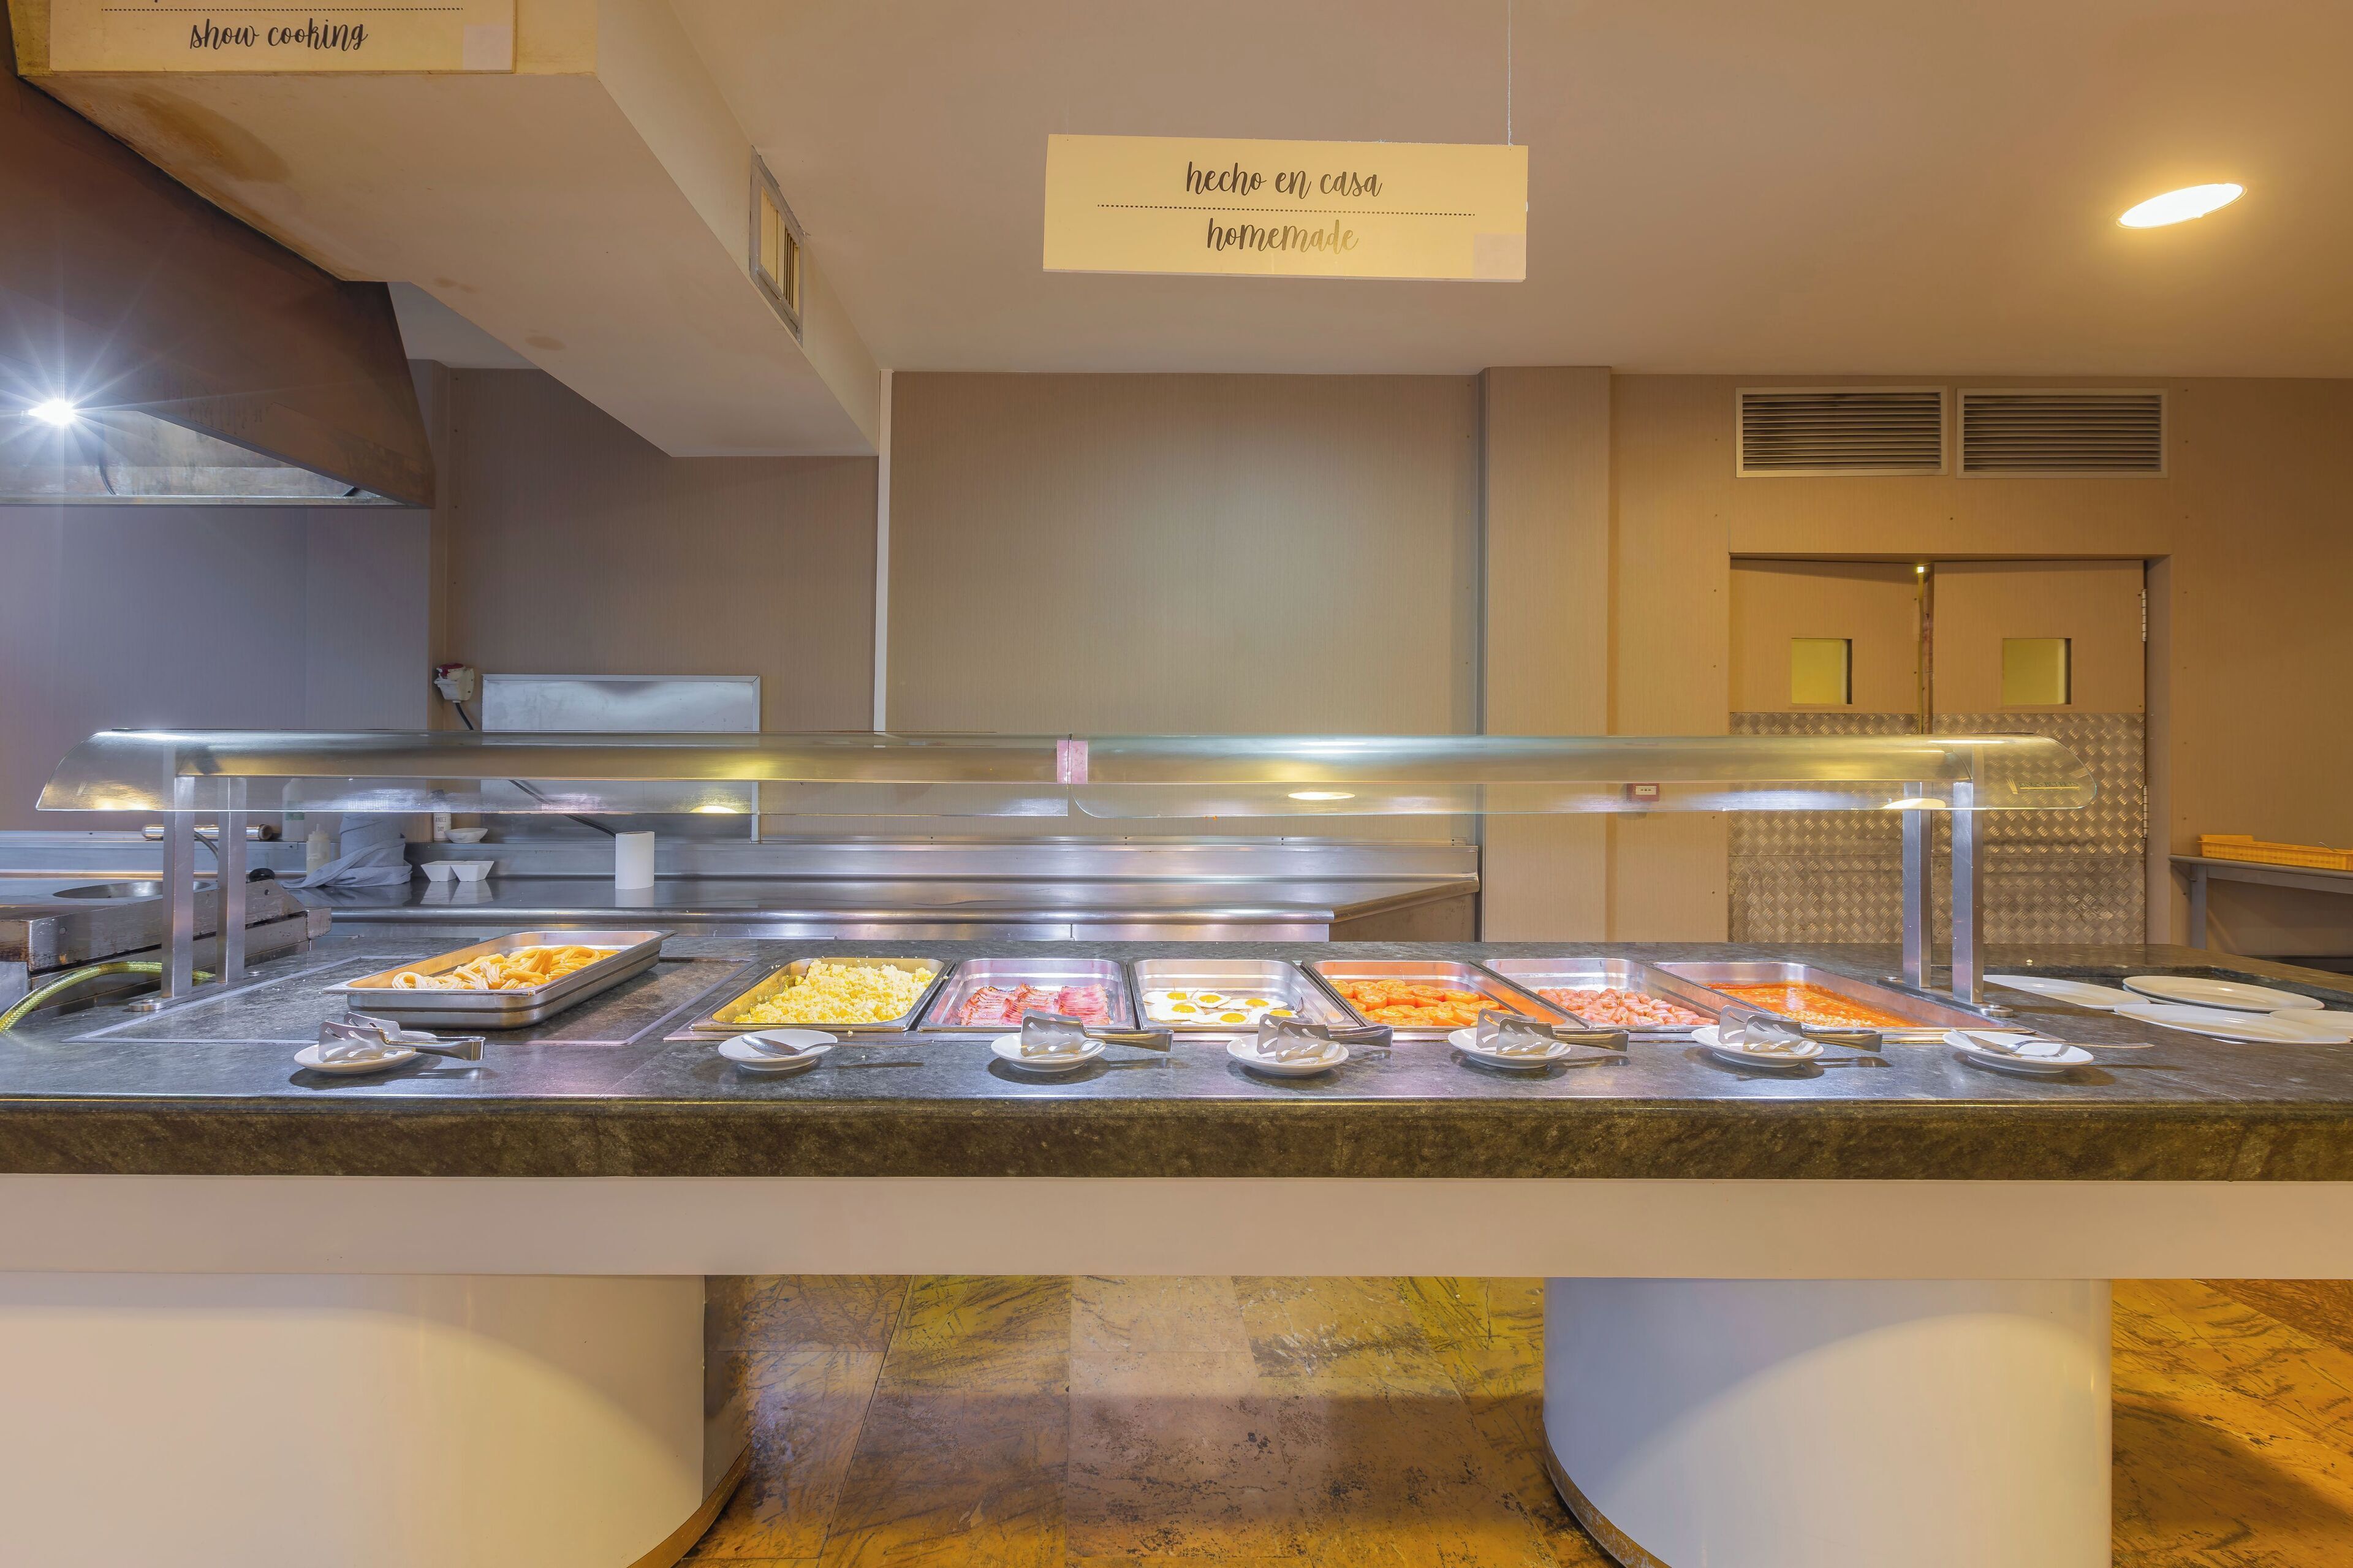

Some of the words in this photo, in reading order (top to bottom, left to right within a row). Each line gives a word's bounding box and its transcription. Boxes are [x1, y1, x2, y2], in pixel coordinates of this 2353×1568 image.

[189, 18, 260, 50] show
[267, 17, 368, 51] cooking
[1186, 161, 1267, 196] hecho
[1275, 170, 1311, 199] en
[1319, 171, 1383, 197] casa
[1207, 217, 1359, 254] homemade
